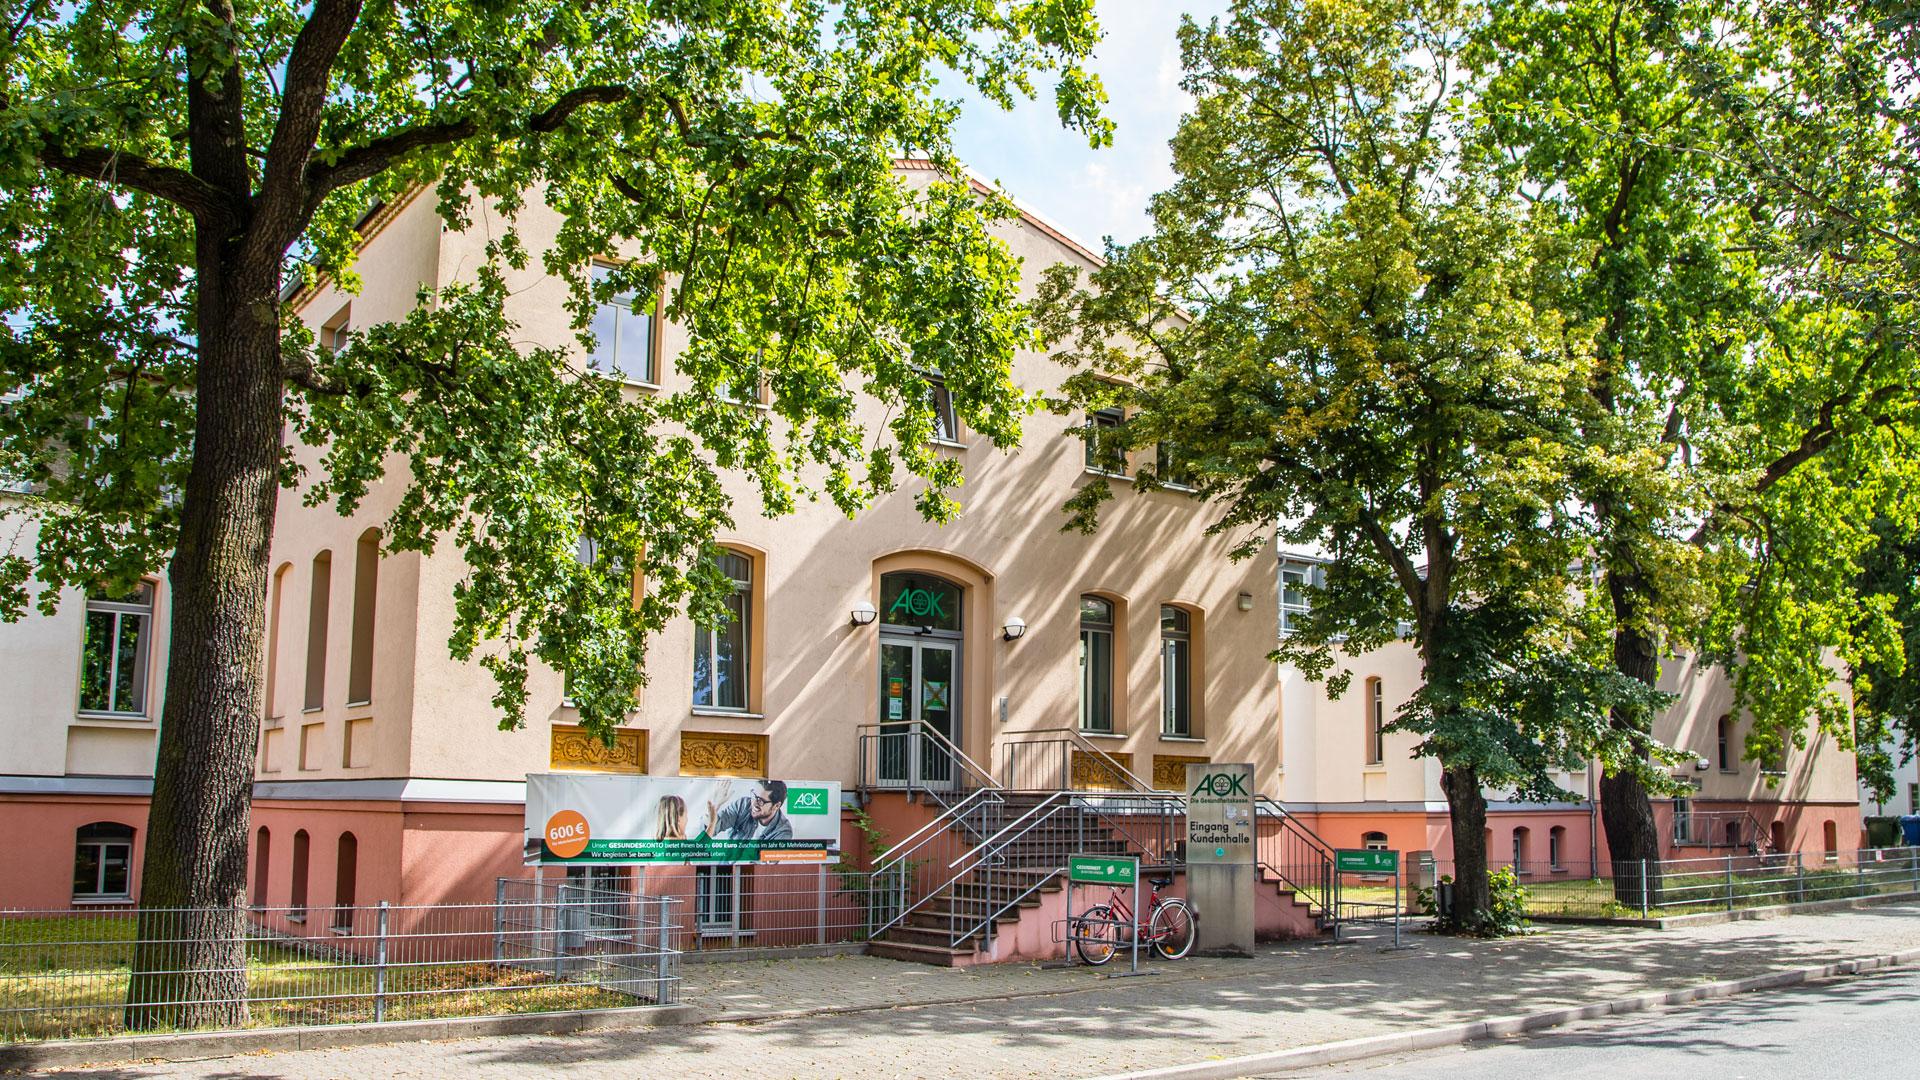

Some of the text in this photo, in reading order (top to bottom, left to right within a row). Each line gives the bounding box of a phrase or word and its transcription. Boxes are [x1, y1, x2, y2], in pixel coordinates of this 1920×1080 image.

[889, 587, 945, 618] AOK
[1191, 773, 1249, 797] AOK
[794, 792, 822, 806] AOK
[550, 822, 585, 840] 600 €
[1190, 821, 1229, 833] Eingang
[1190, 833, 1250, 844] Kundenhalle
